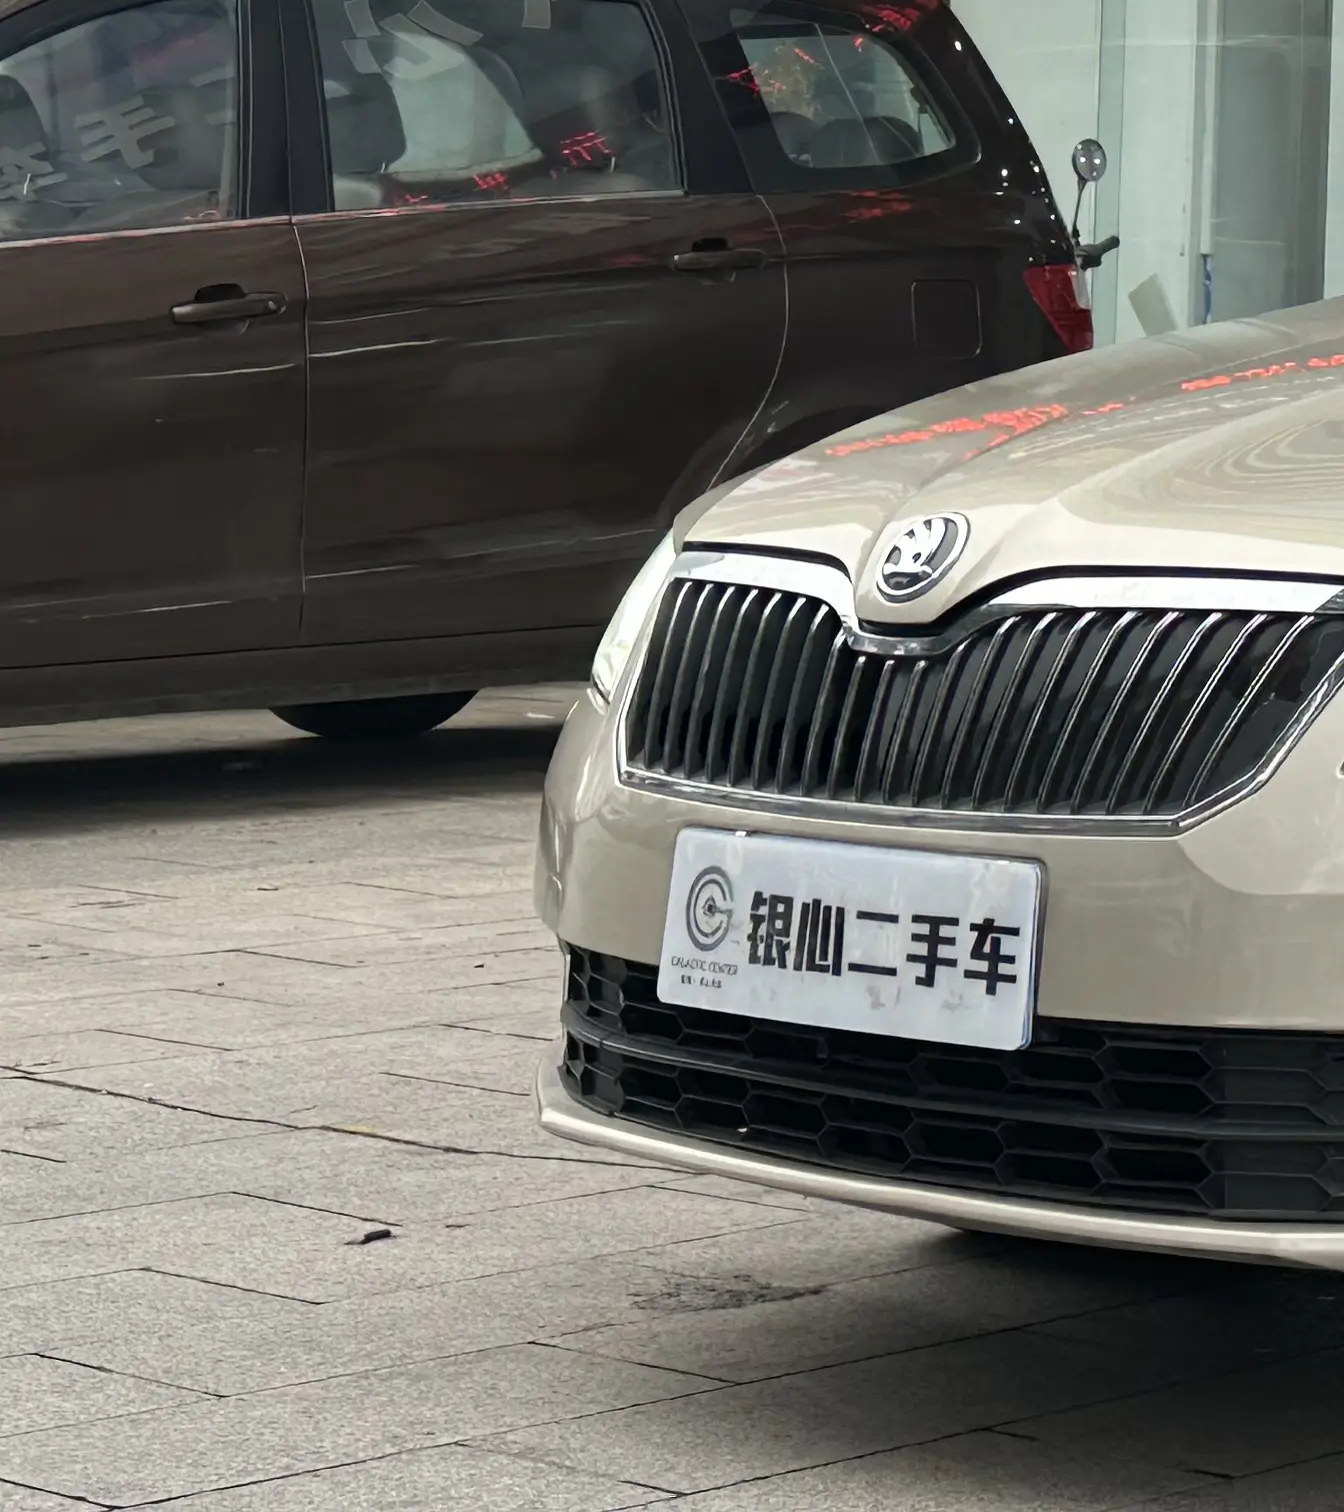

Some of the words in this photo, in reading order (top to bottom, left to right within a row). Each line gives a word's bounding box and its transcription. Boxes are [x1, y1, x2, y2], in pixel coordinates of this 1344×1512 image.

[746, 890, 1021, 996] 银心二手车
